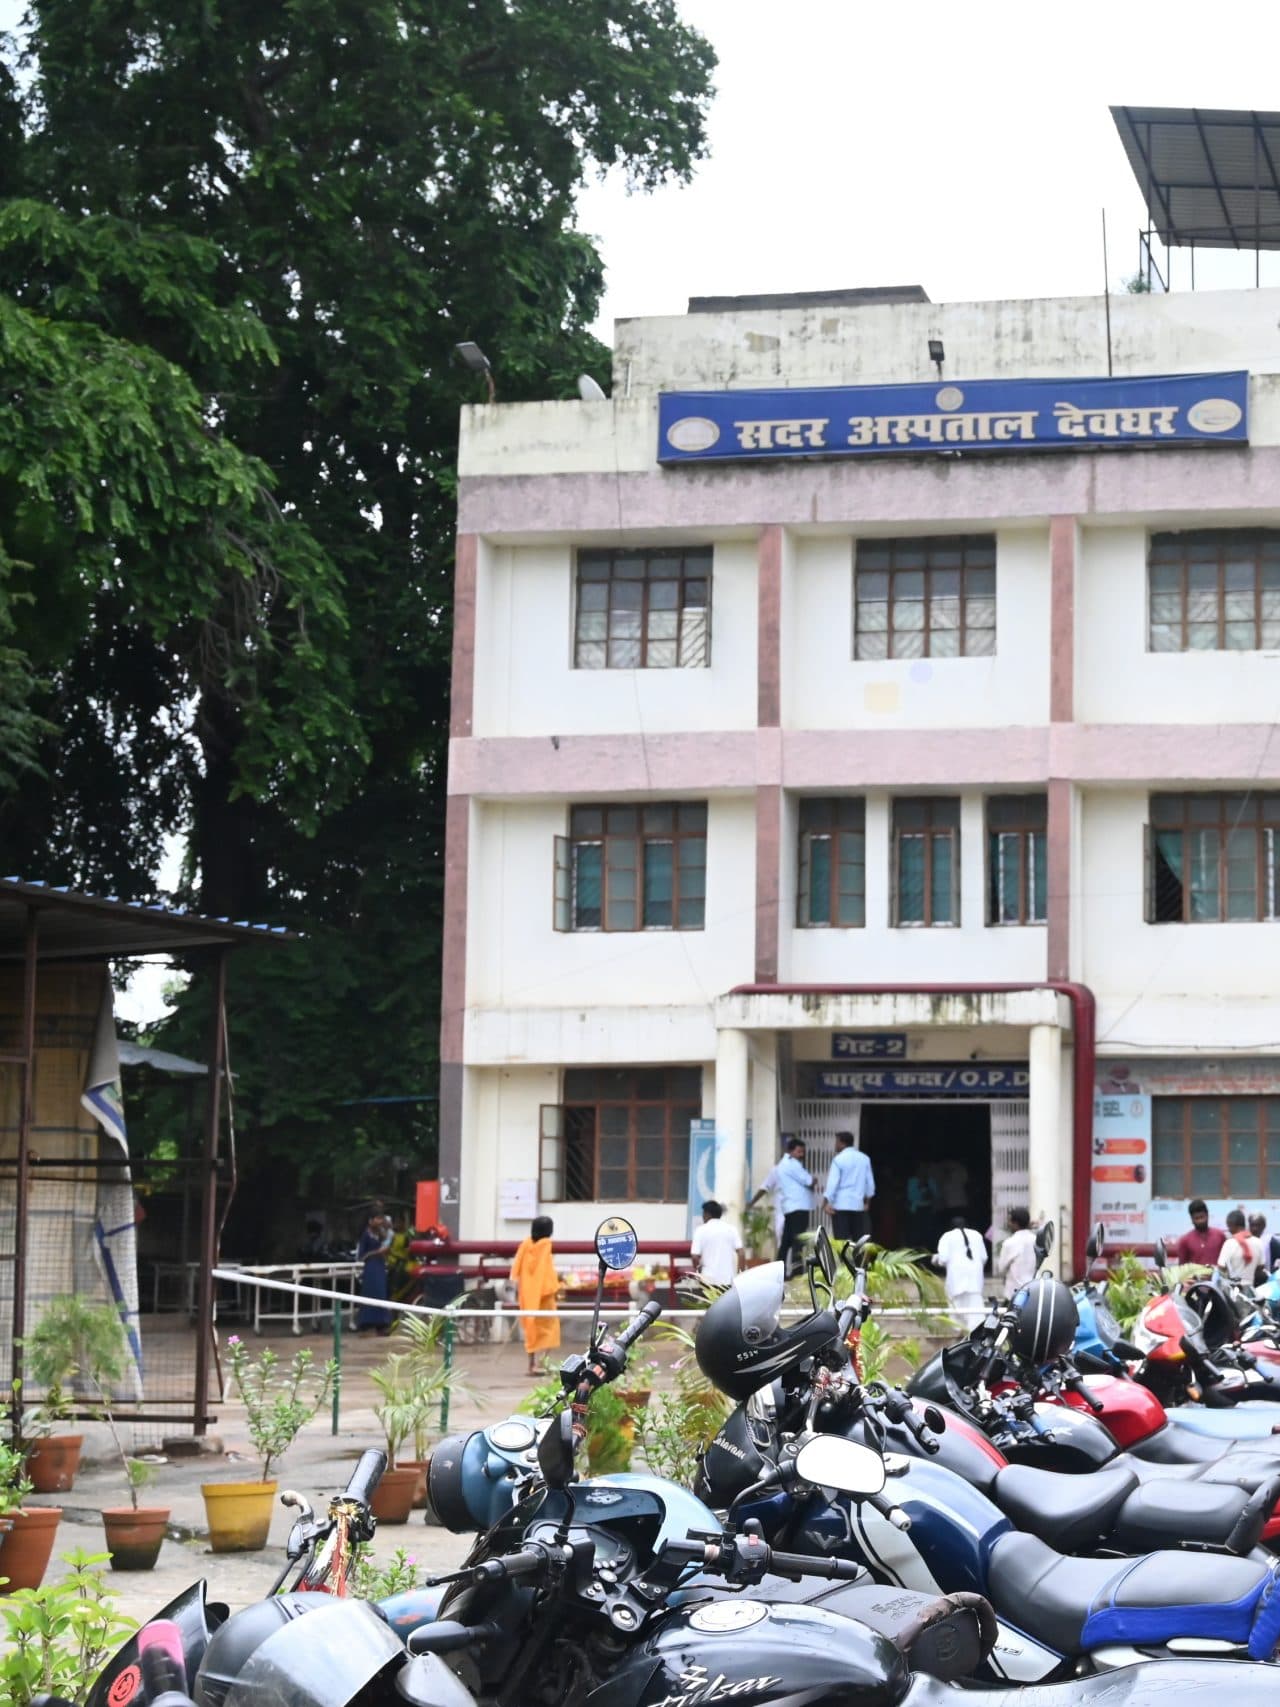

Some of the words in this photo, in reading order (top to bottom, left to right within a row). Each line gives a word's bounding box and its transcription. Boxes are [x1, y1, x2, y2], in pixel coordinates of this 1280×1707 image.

[734, 418, 829, 448] सदर
[847, 411, 1039, 445] अस्पताल
[1053, 402, 1179, 437] देवघर
